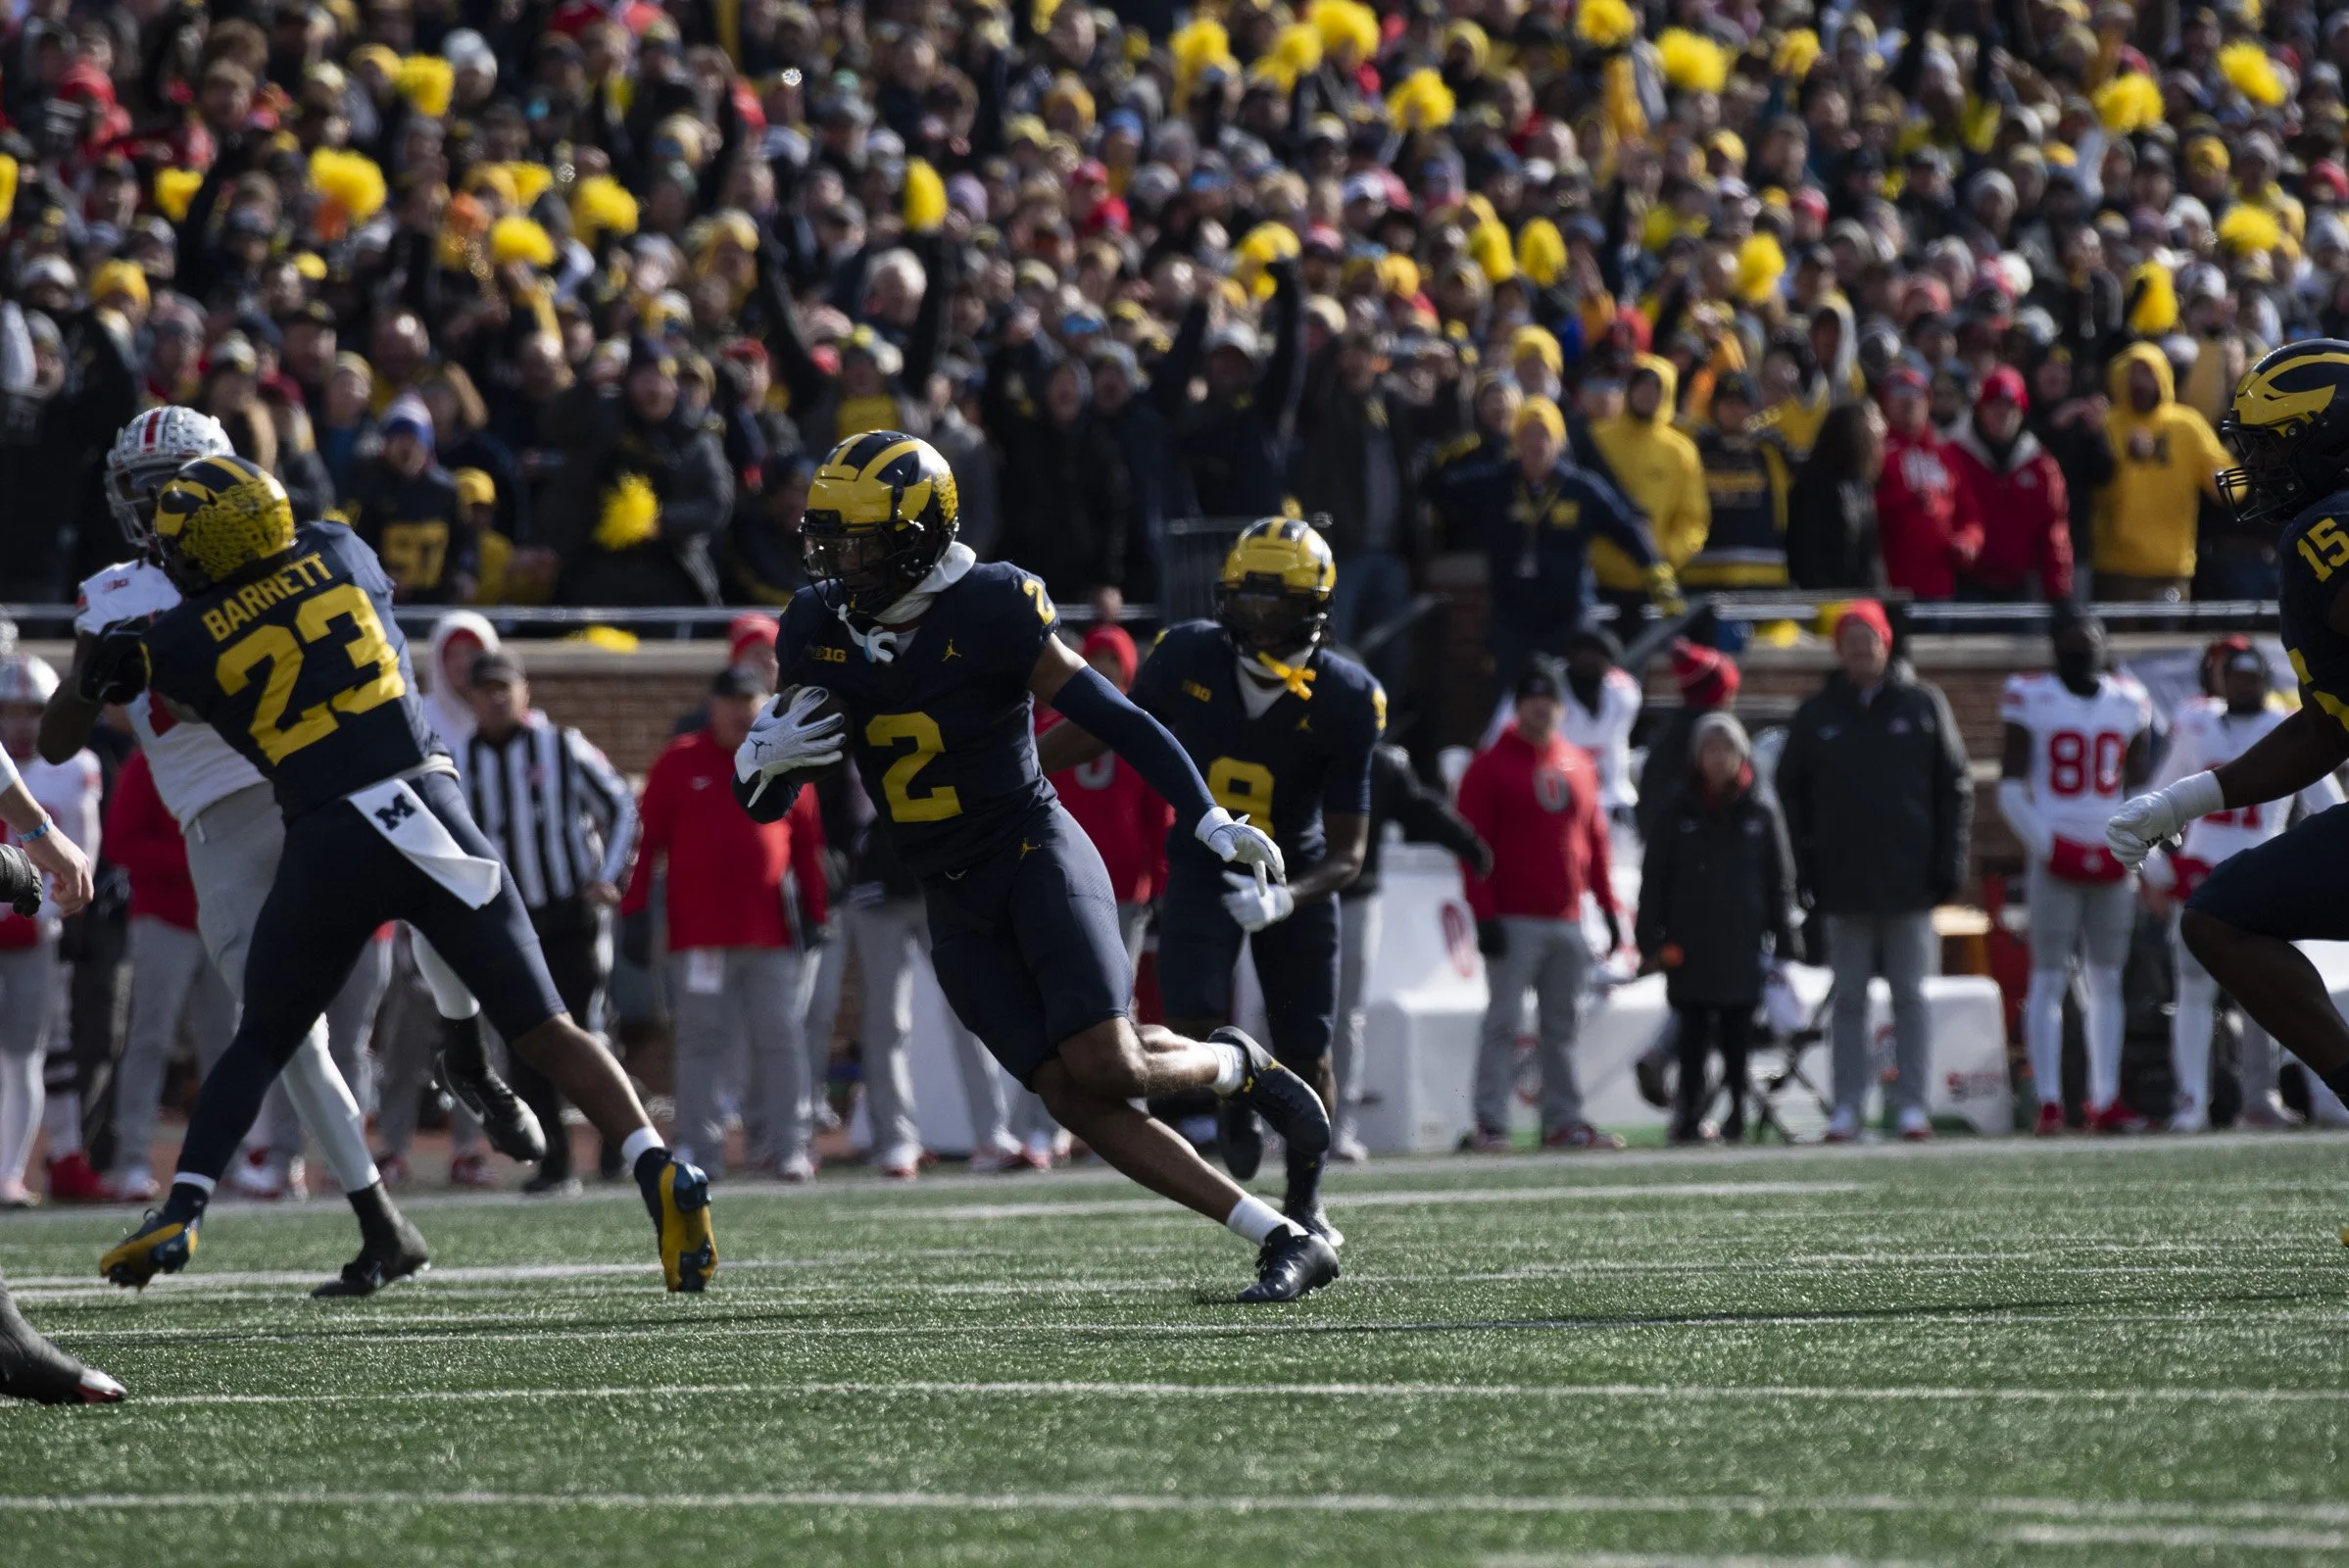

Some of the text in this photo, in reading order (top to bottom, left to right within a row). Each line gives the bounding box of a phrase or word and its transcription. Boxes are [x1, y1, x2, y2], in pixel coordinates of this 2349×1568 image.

[2296, 515, 2349, 583] 15
[201, 552, 333, 642] BARRETT
[1022, 578, 1056, 625] 2
[215, 582, 406, 768] 23
[866, 711, 963, 822] 2
[1207, 756, 1276, 841] 9
[2050, 730, 2127, 796] 80
[375, 792, 416, 832] M
